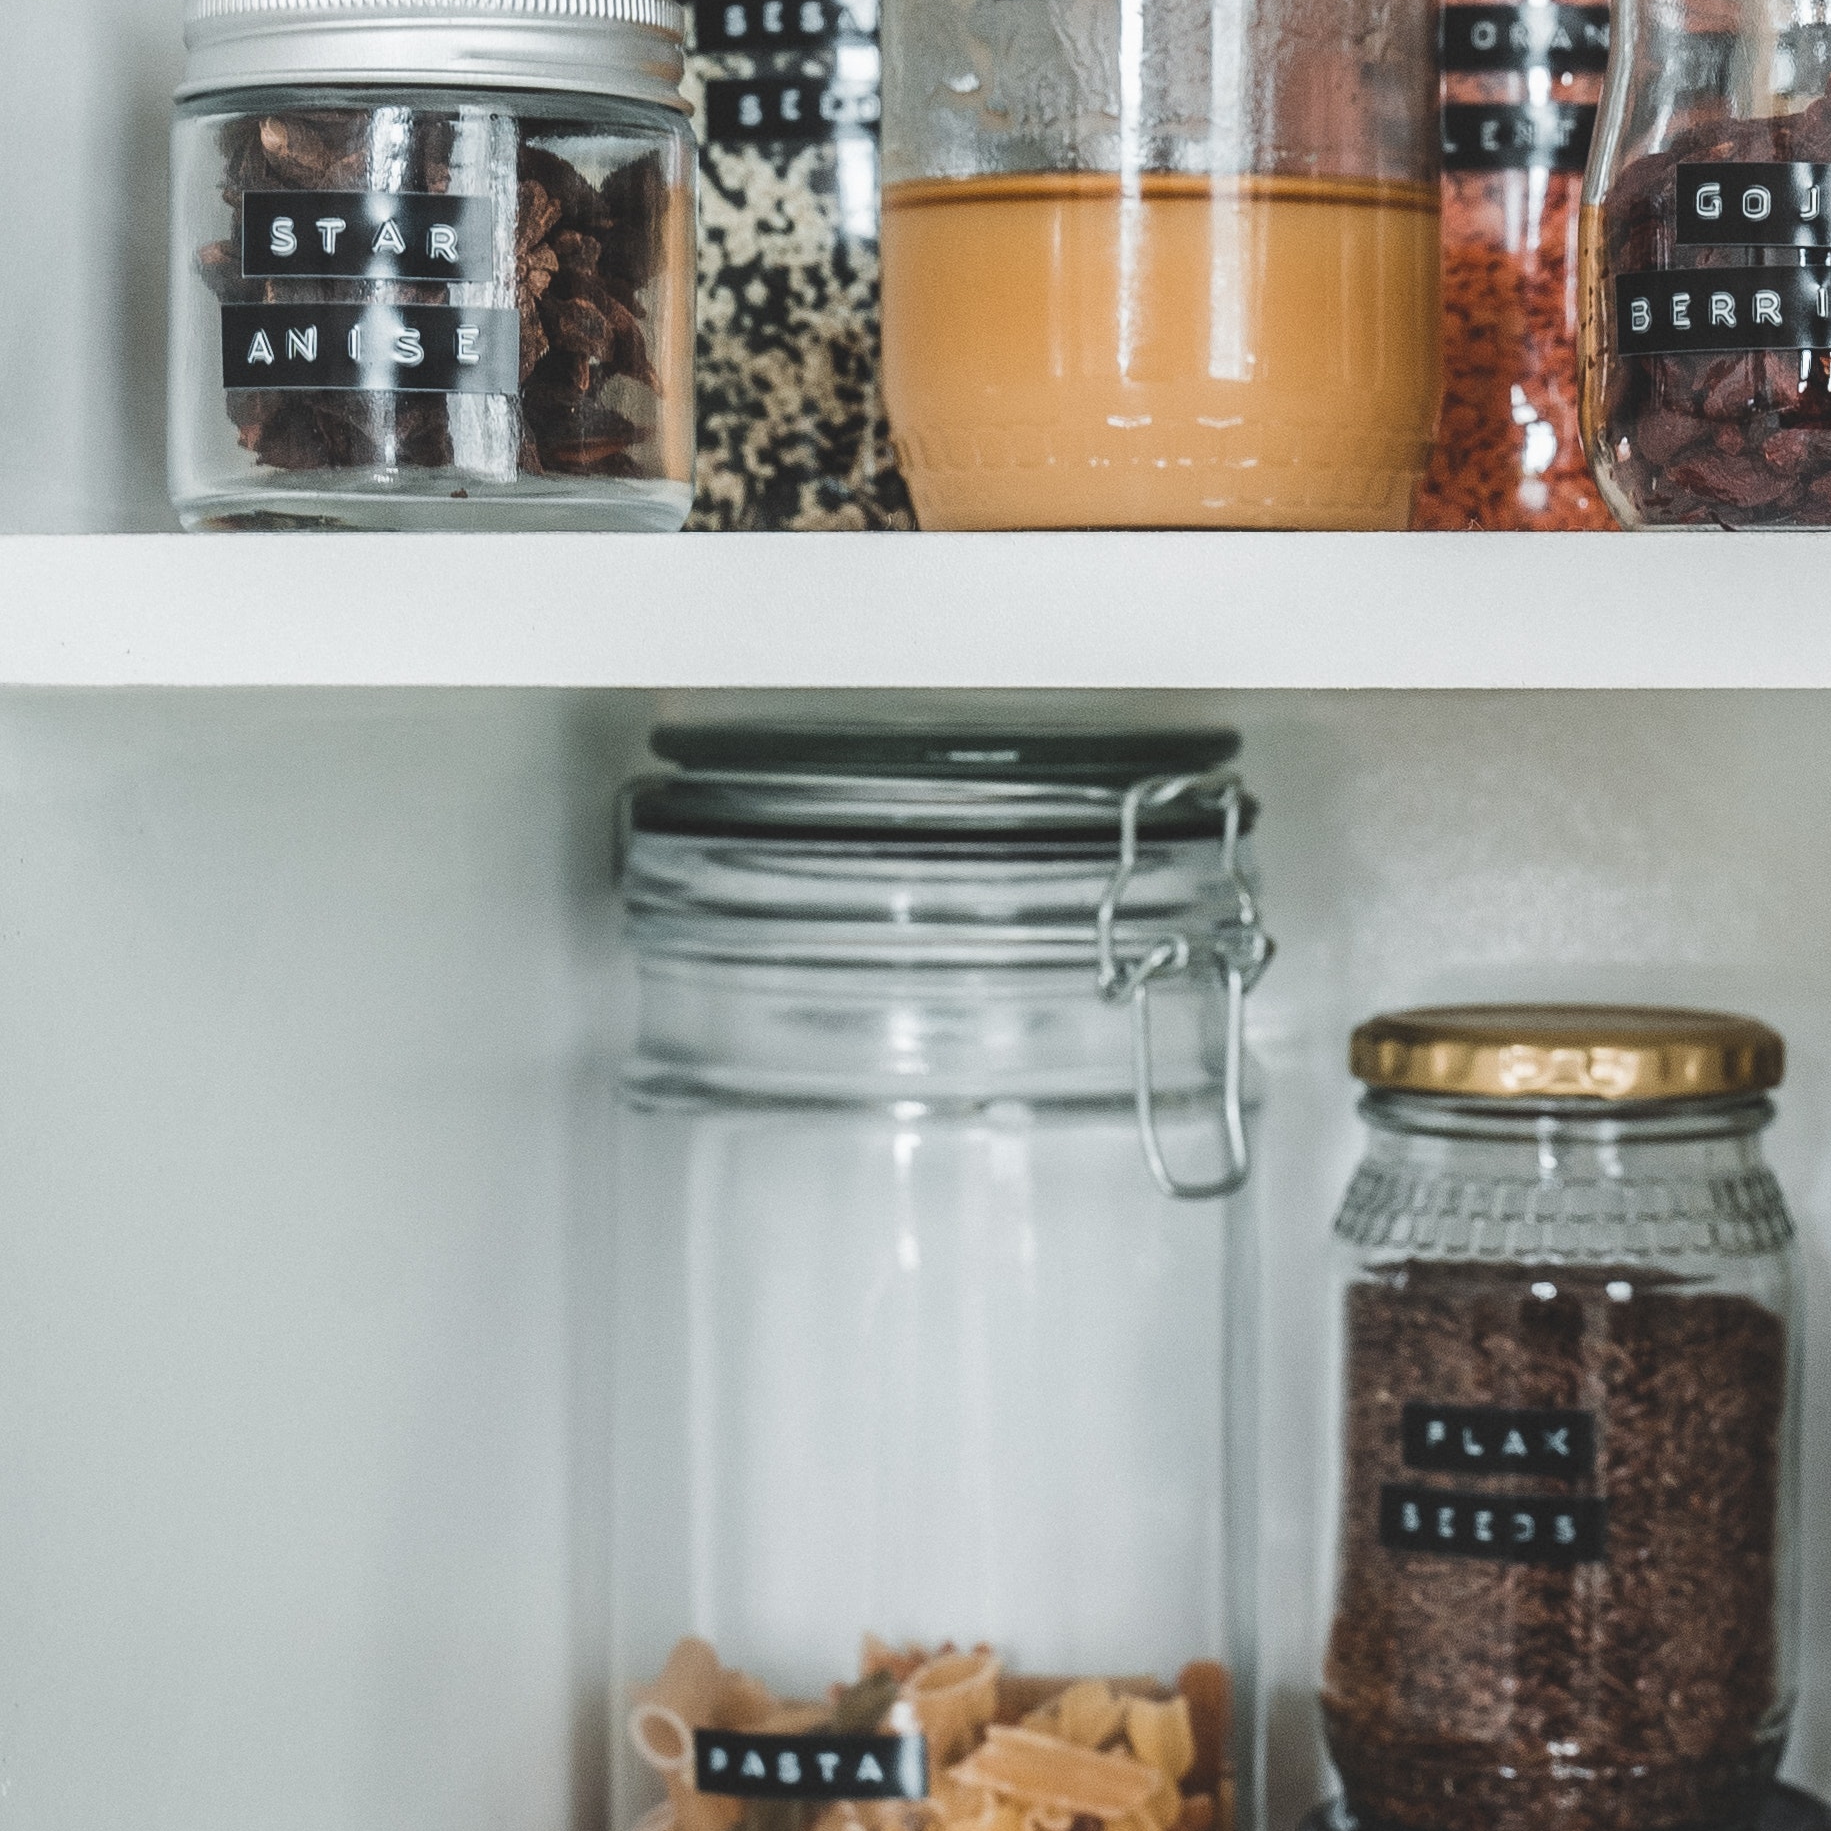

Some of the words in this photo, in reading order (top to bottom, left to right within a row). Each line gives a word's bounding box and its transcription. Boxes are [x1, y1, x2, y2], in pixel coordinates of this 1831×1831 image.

[723, 0, 872, 37] SESA
[1470, 20, 1610, 51] ORAN
[1441, 119, 1578, 153] LENT
[270, 216, 459, 263] STAR
[247, 324, 480, 367] ANISE
[1425, 1419, 1571, 1457] FLAX
[1401, 1501, 1577, 1544] SEEDS
[709, 1746, 884, 1784] PASTA
